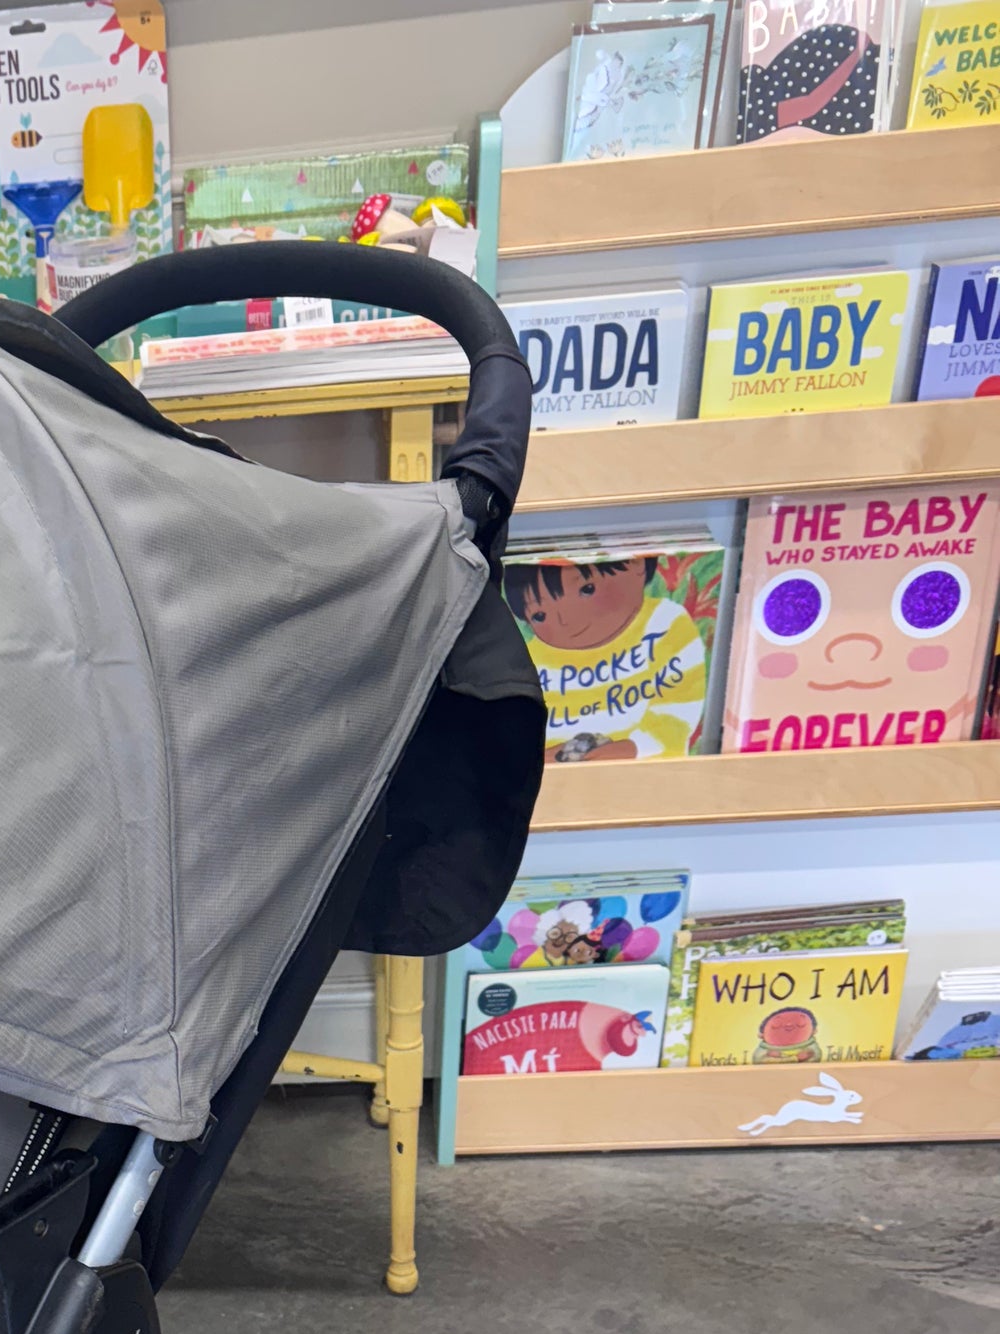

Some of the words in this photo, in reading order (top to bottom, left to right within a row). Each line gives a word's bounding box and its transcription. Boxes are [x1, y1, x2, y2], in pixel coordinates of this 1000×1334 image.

[934, 22, 1000, 46] WELC
[4, 74, 61, 105] TOOLS
[649, 308, 660, 317] BE
[791, 295, 817, 305] THIS
[953, 277, 1000, 344] N
[519, 319, 658, 395] DADA
[733, 299, 882, 376] BABY
[729, 377, 790, 401] JIMMY
[794, 371, 867, 392] FALLON
[944, 359, 1000, 382] JIMM
[531, 395, 576, 413] MMY
[581, 389, 658, 410] FALLON
[768, 503, 846, 544] THE
[863, 493, 988, 538] BABY
[765, 548, 815, 566] WHO
[821, 543, 899, 562] STAYED
[904, 538, 977, 558] AWAKE
[538, 668, 551, 691] A
[560, 630, 668, 696] POCKET
[549, 706, 579, 728] LL
[580, 701, 602, 716] OF
[606, 657, 684, 716] ROCKS
[740, 709, 946, 753] FOREVER
[712, 971, 795, 1005] WHO
[809, 967, 826, 1000] I
[837, 965, 889, 1001] AM
[472, 1014, 537, 1051] NACISTE
[540, 1010, 579, 1031] PARA
